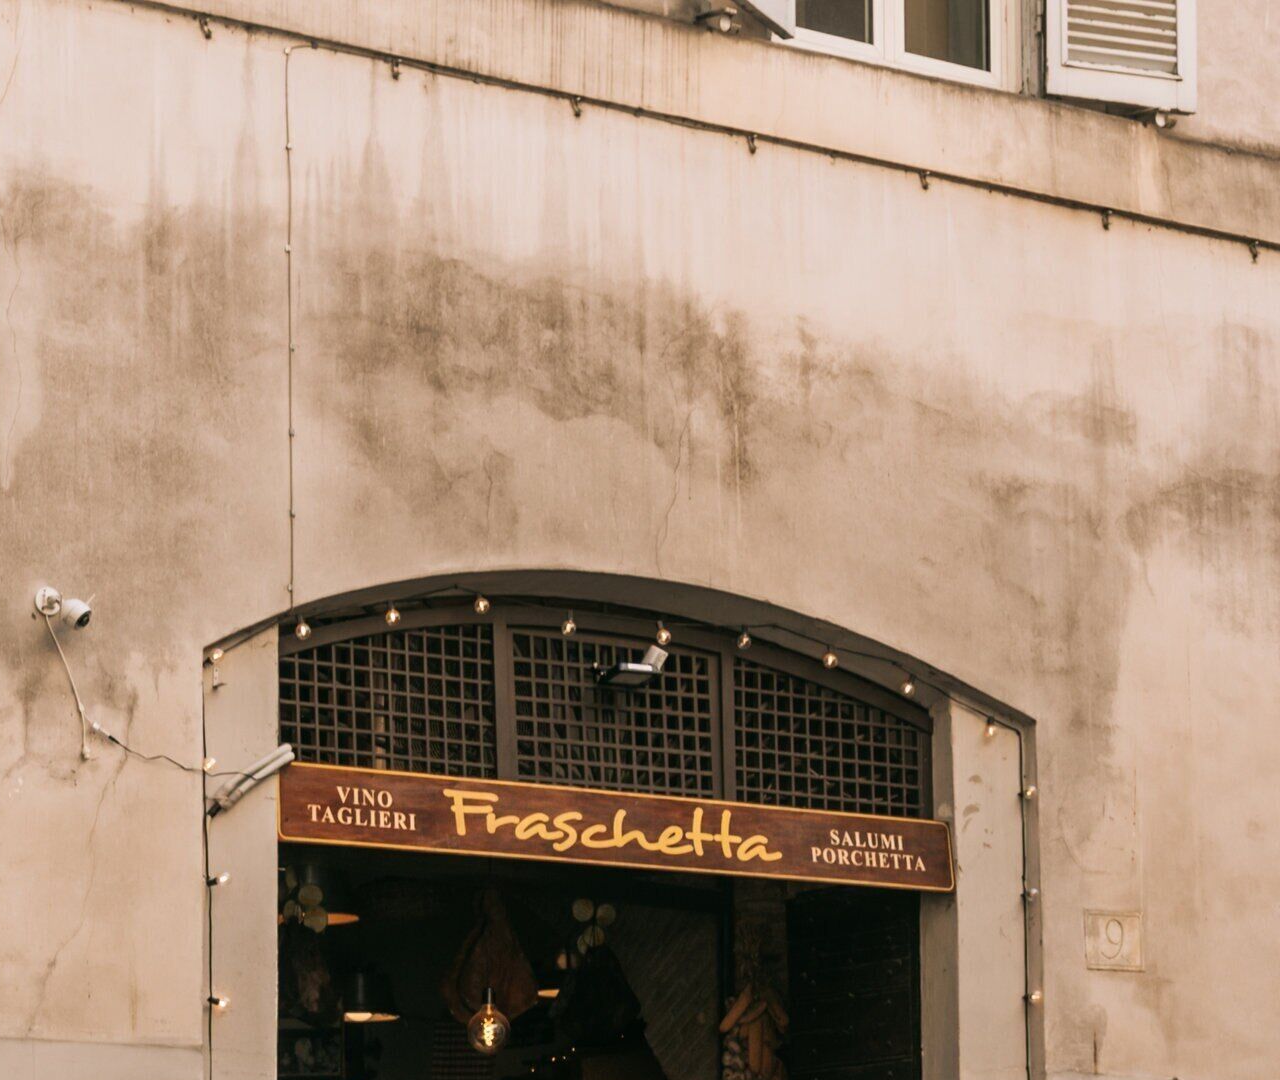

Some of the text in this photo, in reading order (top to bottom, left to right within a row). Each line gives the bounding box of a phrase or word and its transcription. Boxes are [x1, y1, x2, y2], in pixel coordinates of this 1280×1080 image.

[336, 786, 394, 809] VINO
[307, 803, 417, 831] TAGLIERI
[443, 788, 783, 862] Fraschetta
[829, 828, 905, 851] SALUMI
[811, 847, 927, 873] PORCHETTA
